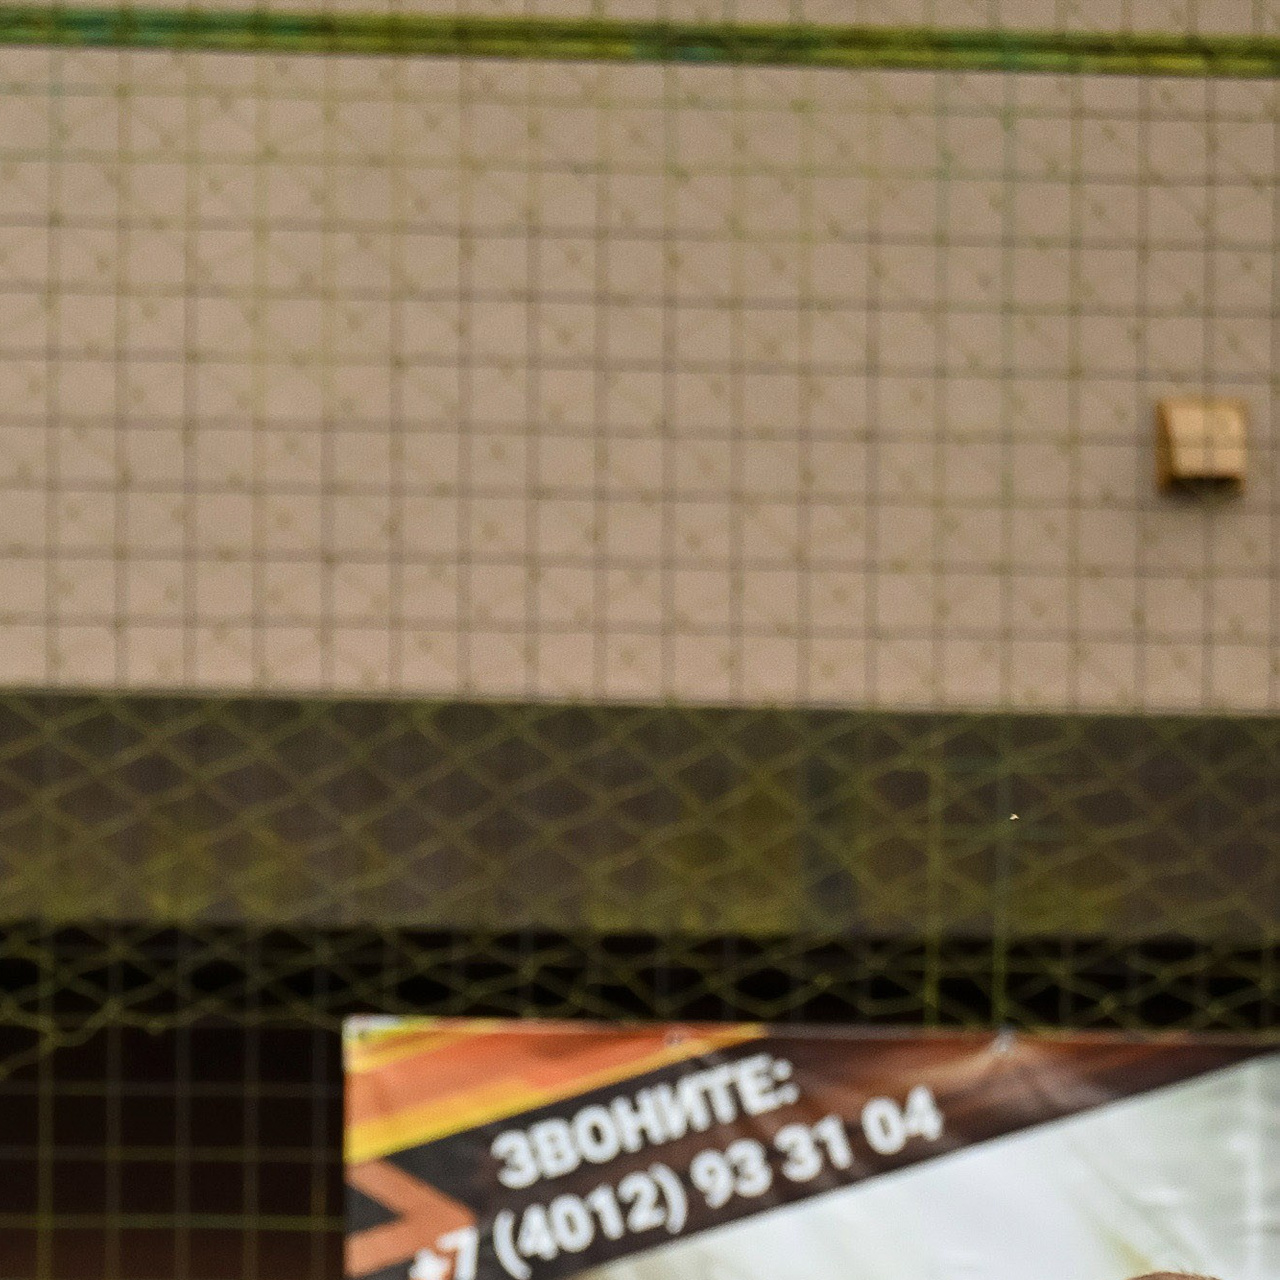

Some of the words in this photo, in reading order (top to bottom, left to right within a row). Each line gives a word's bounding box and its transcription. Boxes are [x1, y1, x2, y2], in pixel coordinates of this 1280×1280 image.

[491, 1054, 800, 1190] ЗВОНИТЕ:
[693, 1137, 774, 1209] 93
[781, 1114, 854, 1183] 31
[863, 1085, 945, 1157] 04
